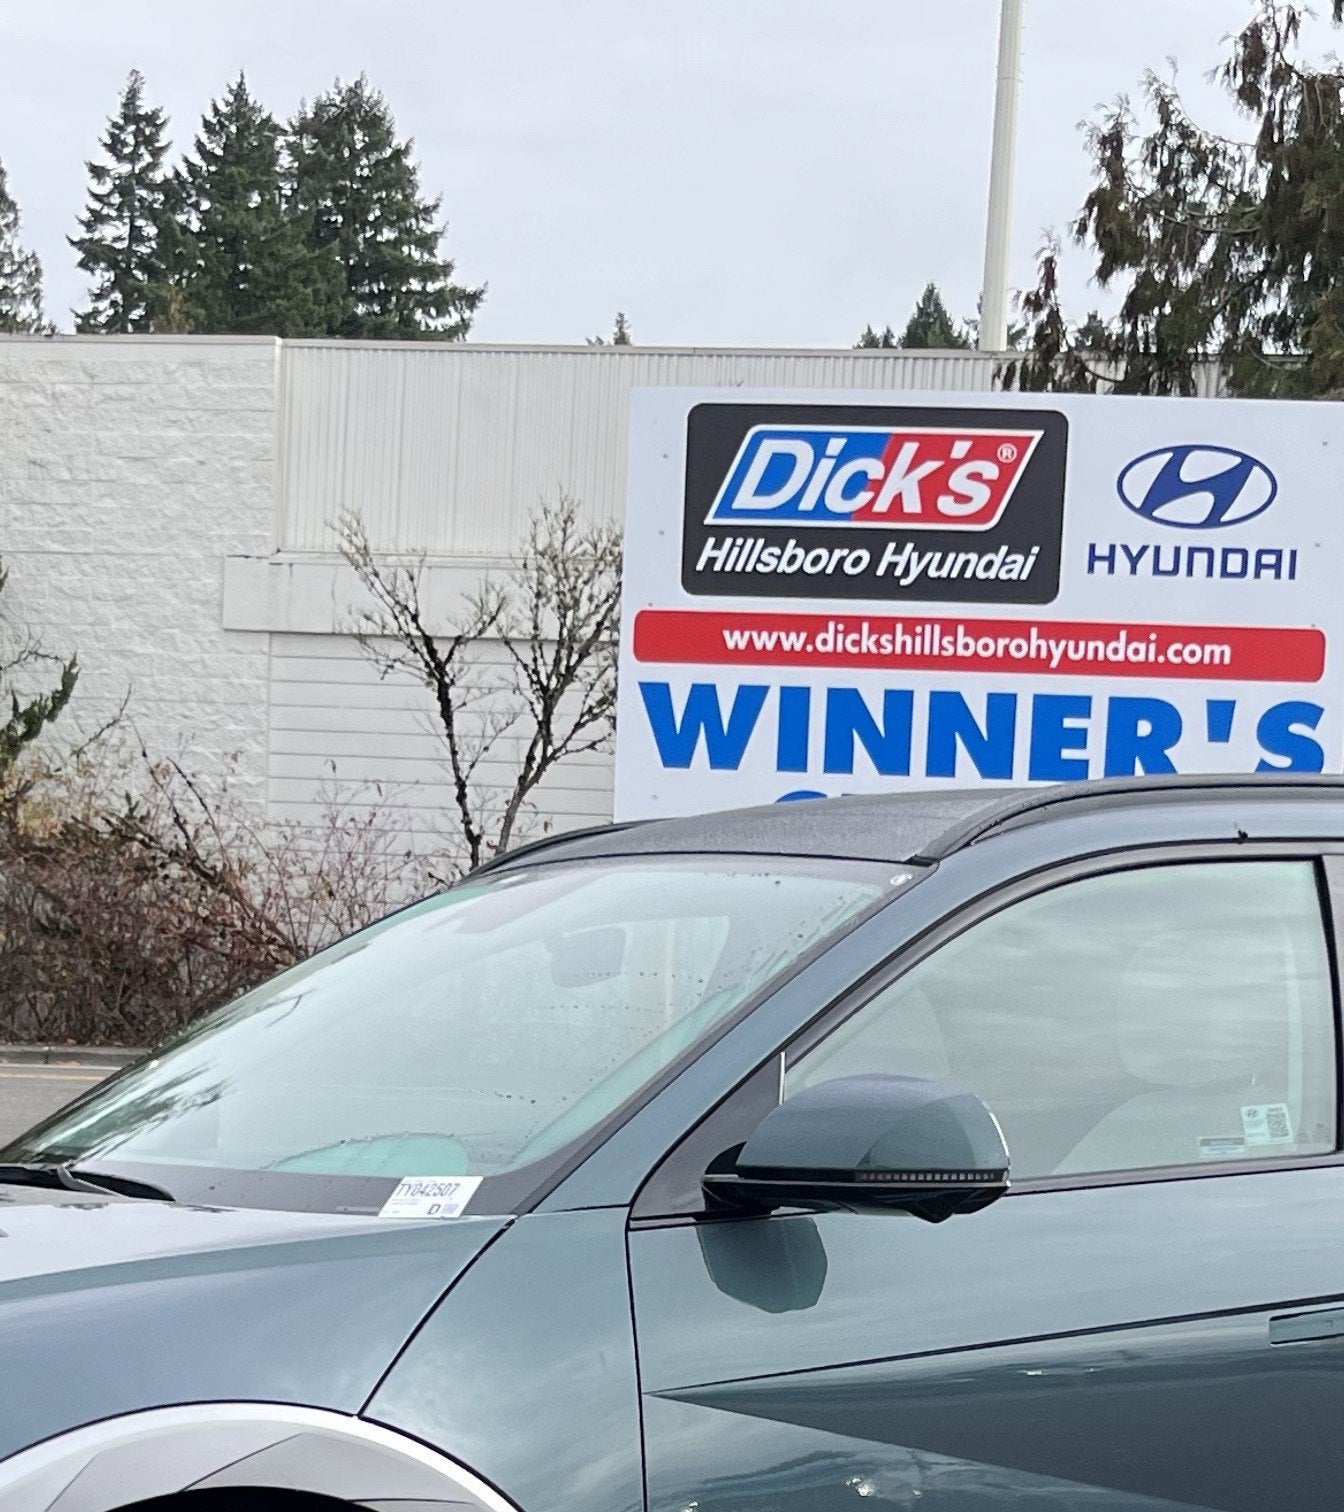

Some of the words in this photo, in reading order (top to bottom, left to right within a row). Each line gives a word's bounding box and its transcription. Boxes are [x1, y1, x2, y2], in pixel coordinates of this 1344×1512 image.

[731, 437, 1000, 517] Dick's
[694, 537, 871, 577] Hillsboro
[875, 542, 1040, 587] Hyundai
[1086, 542, 1298, 581] HYUNDAI
[721, 619, 1233, 670] www.dickshillsborohyundai.com
[638, 681, 1325, 781] WINNER'S
